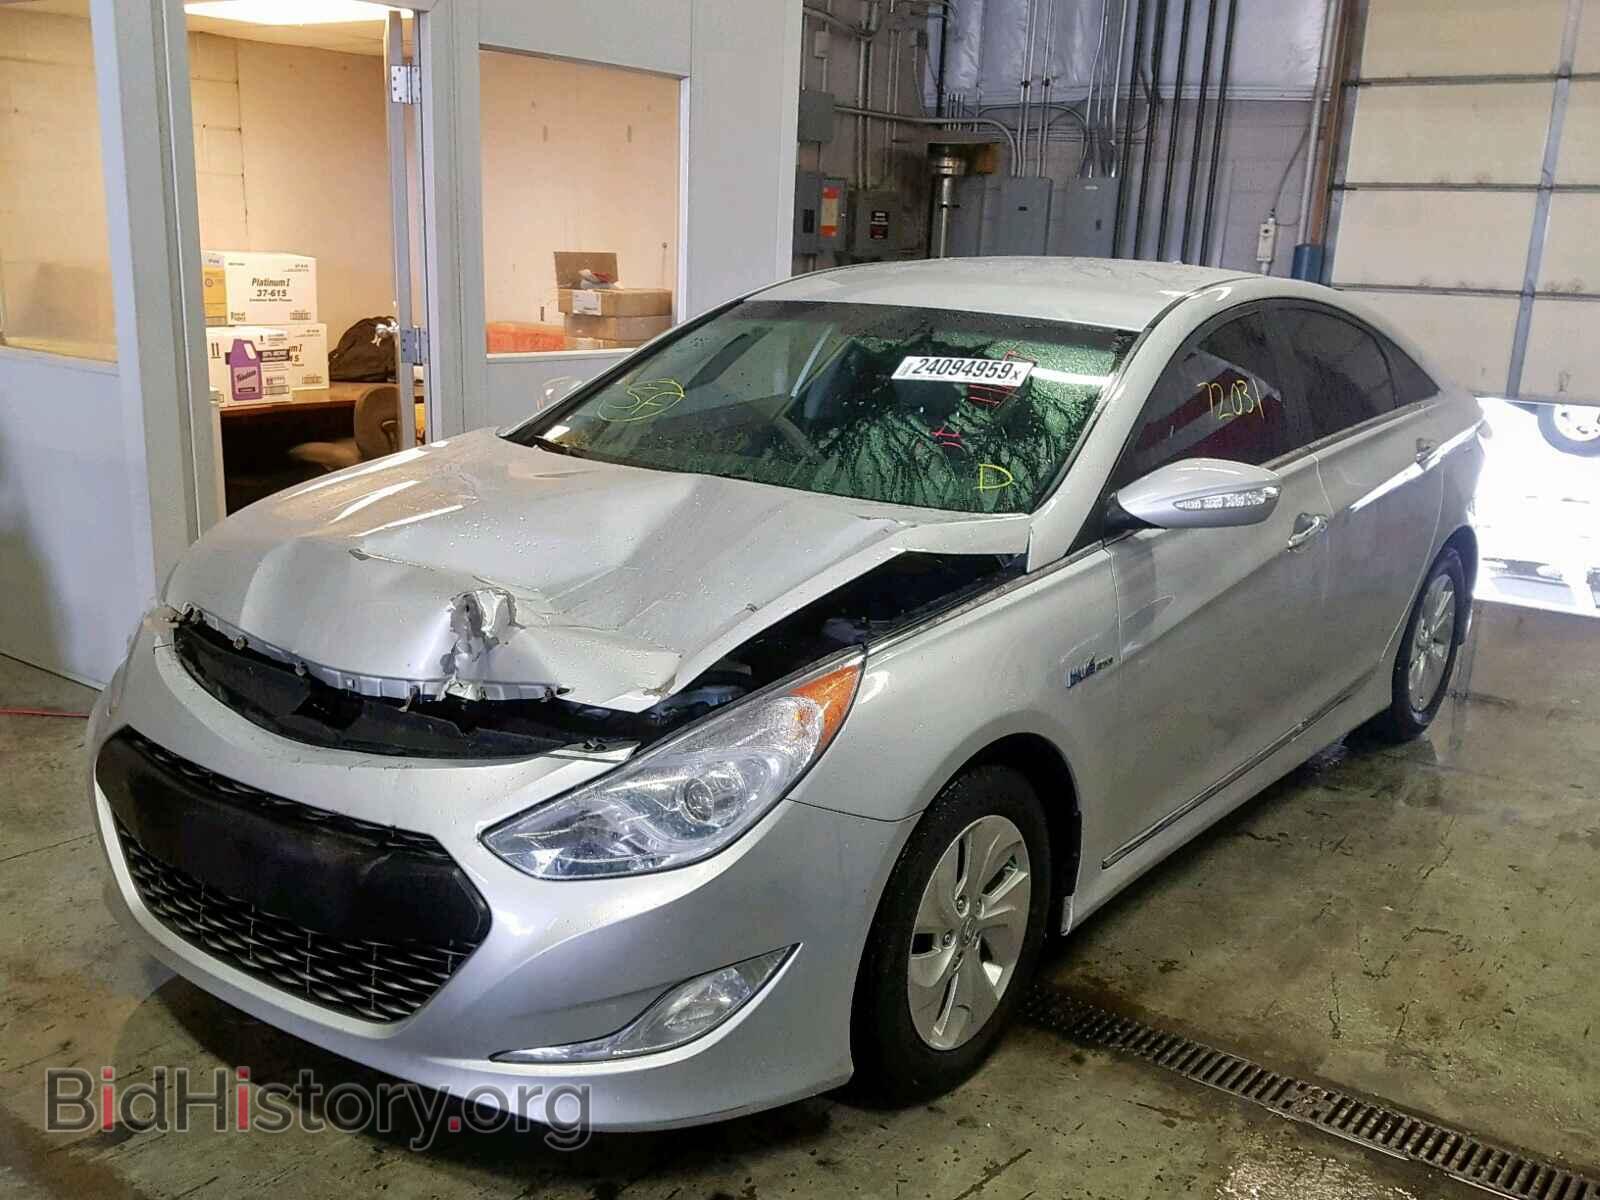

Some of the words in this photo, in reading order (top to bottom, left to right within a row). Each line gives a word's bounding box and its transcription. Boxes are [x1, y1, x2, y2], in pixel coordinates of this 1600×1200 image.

[251, 277, 286, 287] Platinum
[256, 289, 287, 297] 37-615
[978, 463, 1013, 494] D
